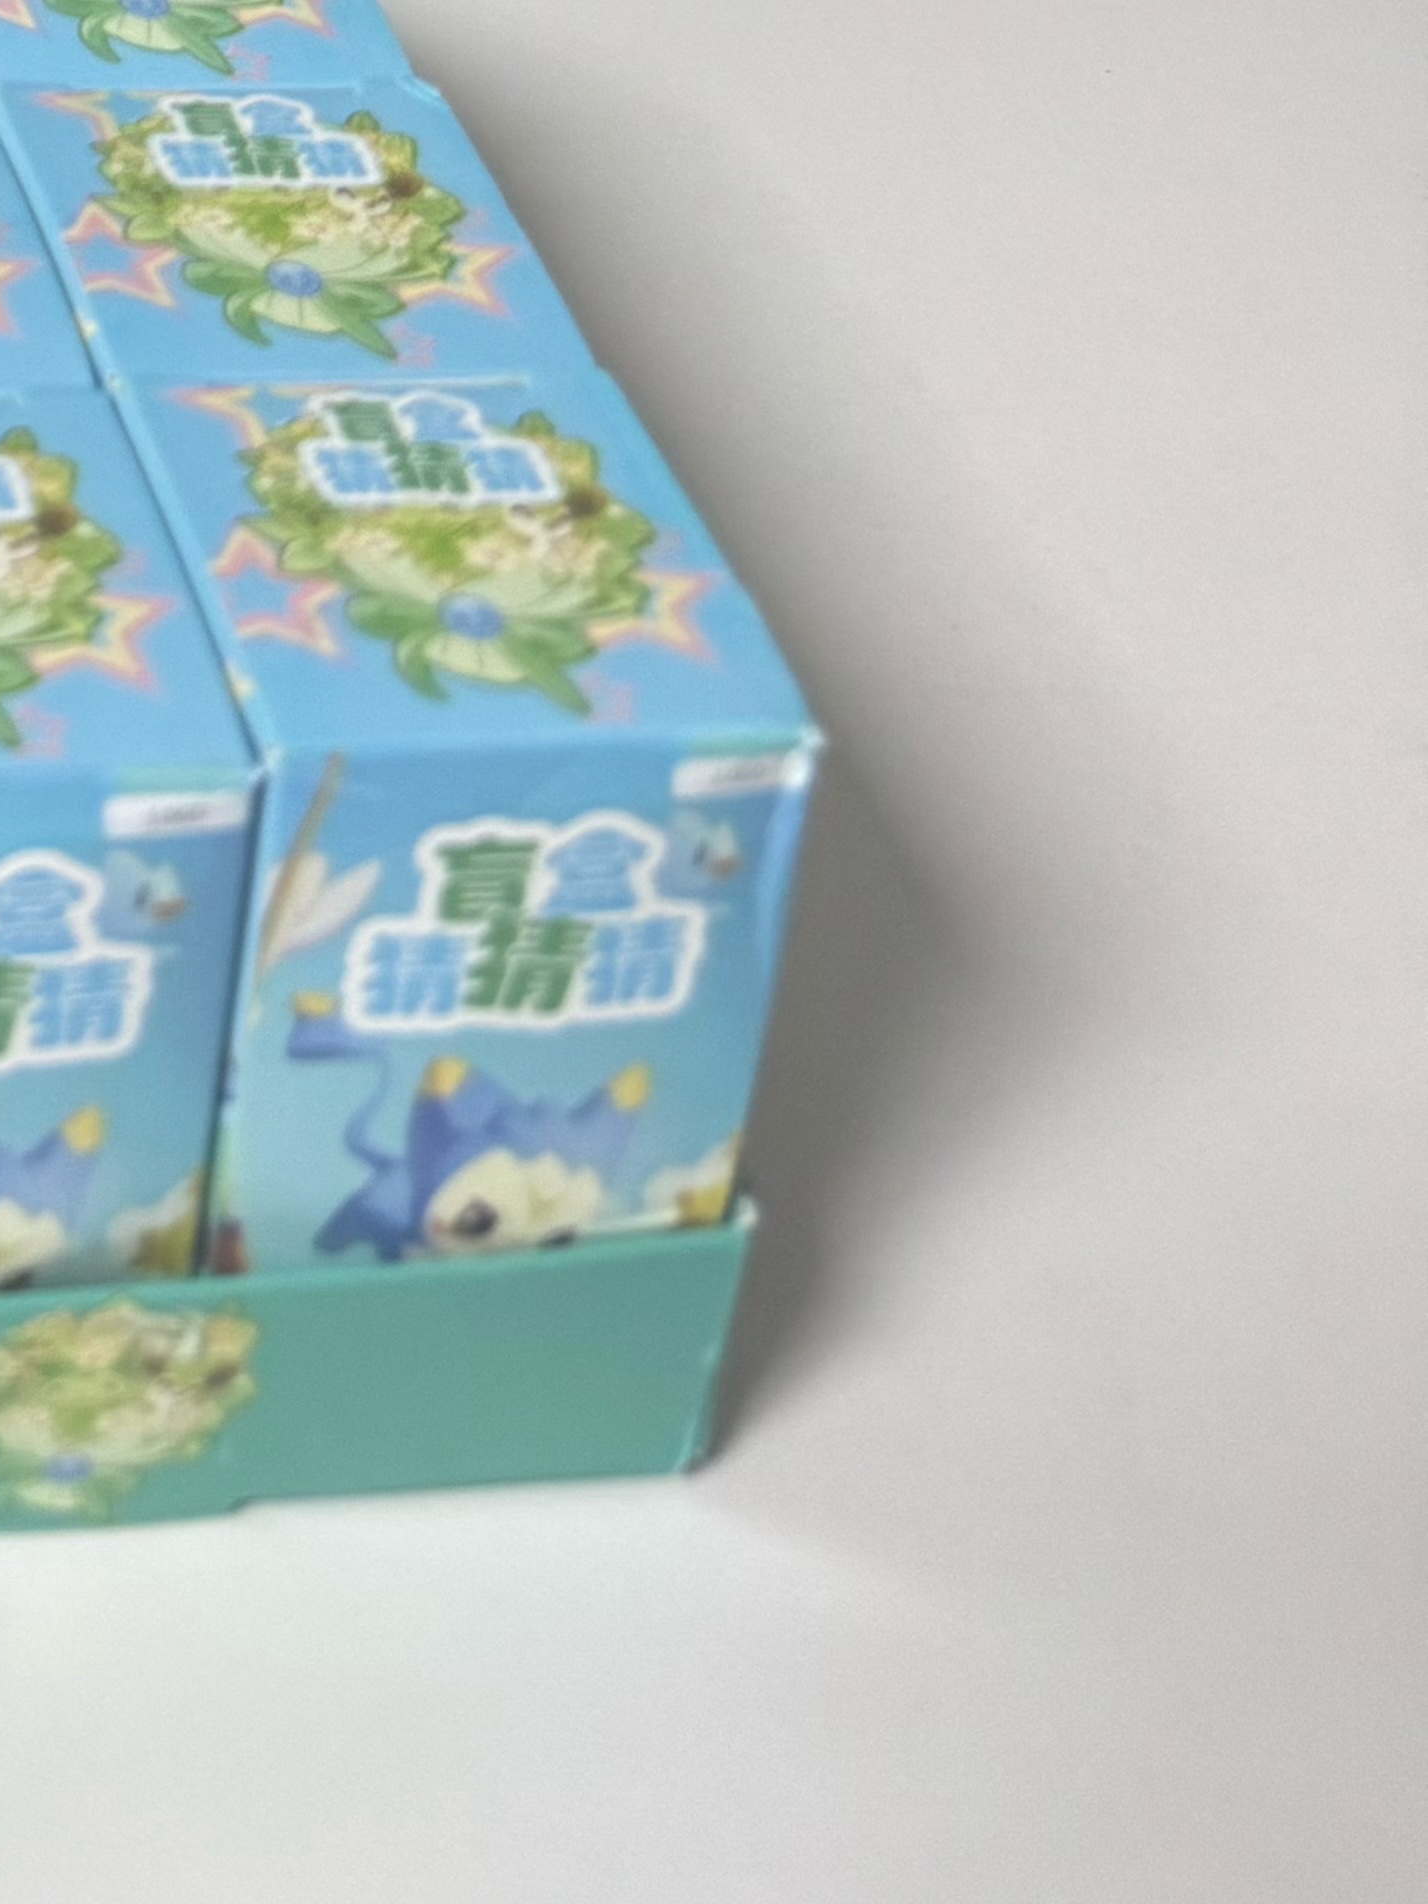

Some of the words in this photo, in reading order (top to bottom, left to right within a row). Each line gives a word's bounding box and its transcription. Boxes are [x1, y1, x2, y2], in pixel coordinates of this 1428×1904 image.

[437, 830, 648, 928] 盲盒
[367, 914, 685, 1017] 猜猜猜
